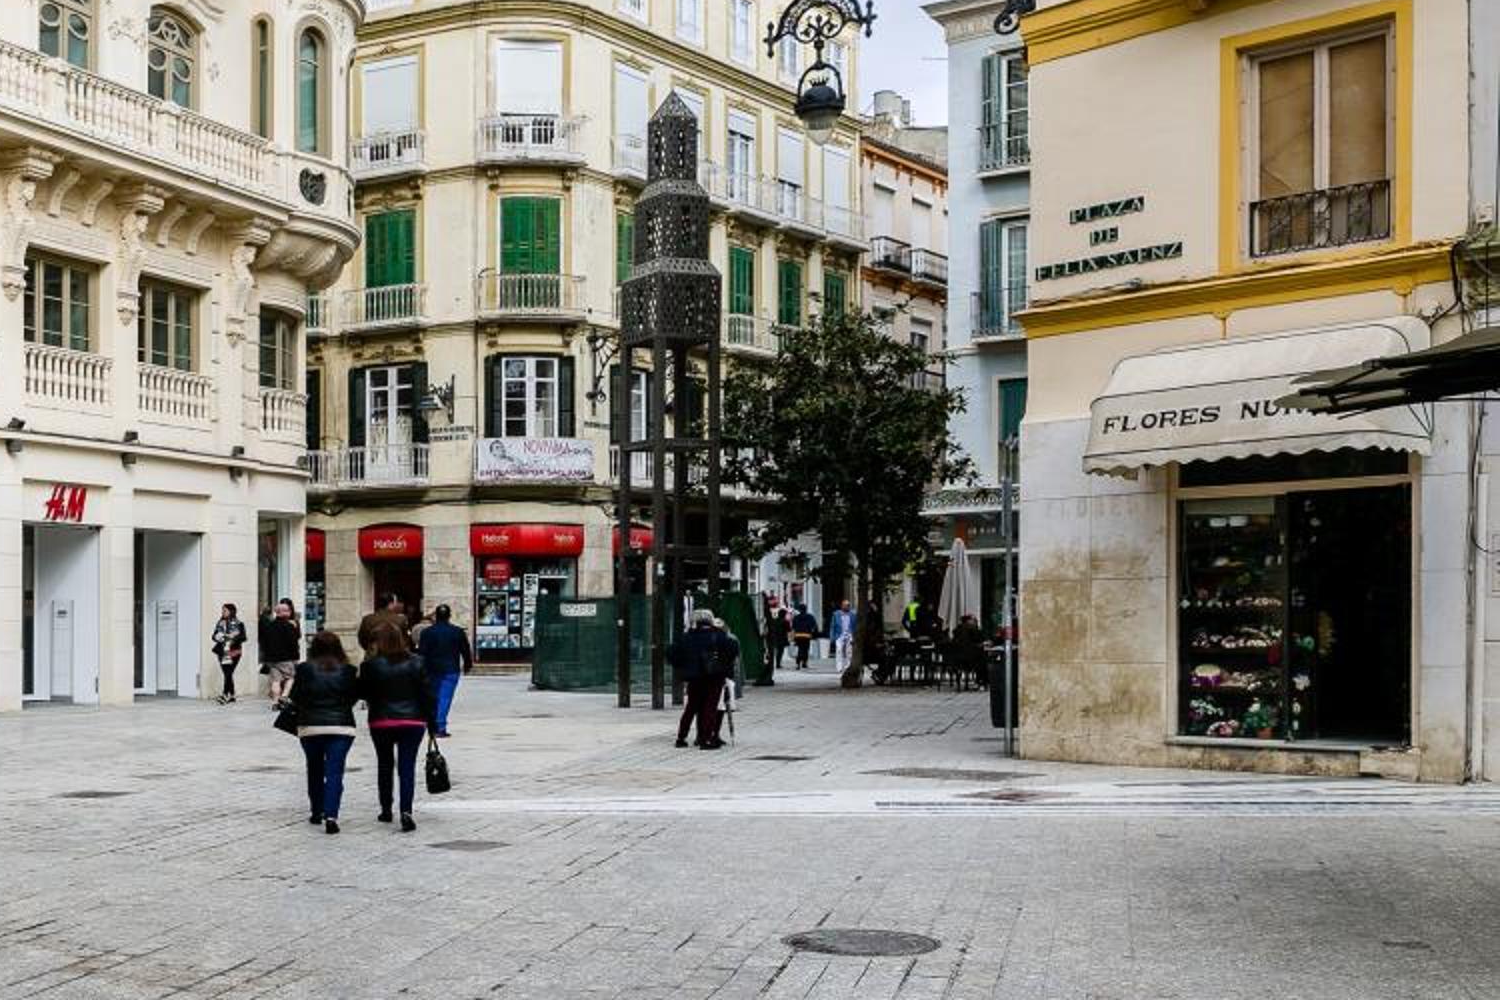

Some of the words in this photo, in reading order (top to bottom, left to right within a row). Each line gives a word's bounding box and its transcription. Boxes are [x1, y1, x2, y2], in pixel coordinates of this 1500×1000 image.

[1070, 196, 1144, 225] PLAZA
[1090, 227, 1118, 247] DE
[1035, 258, 1099, 281] FELIX
[1102, 406, 1221, 435] FLORES
[45, 484, 87, 522] H&M
